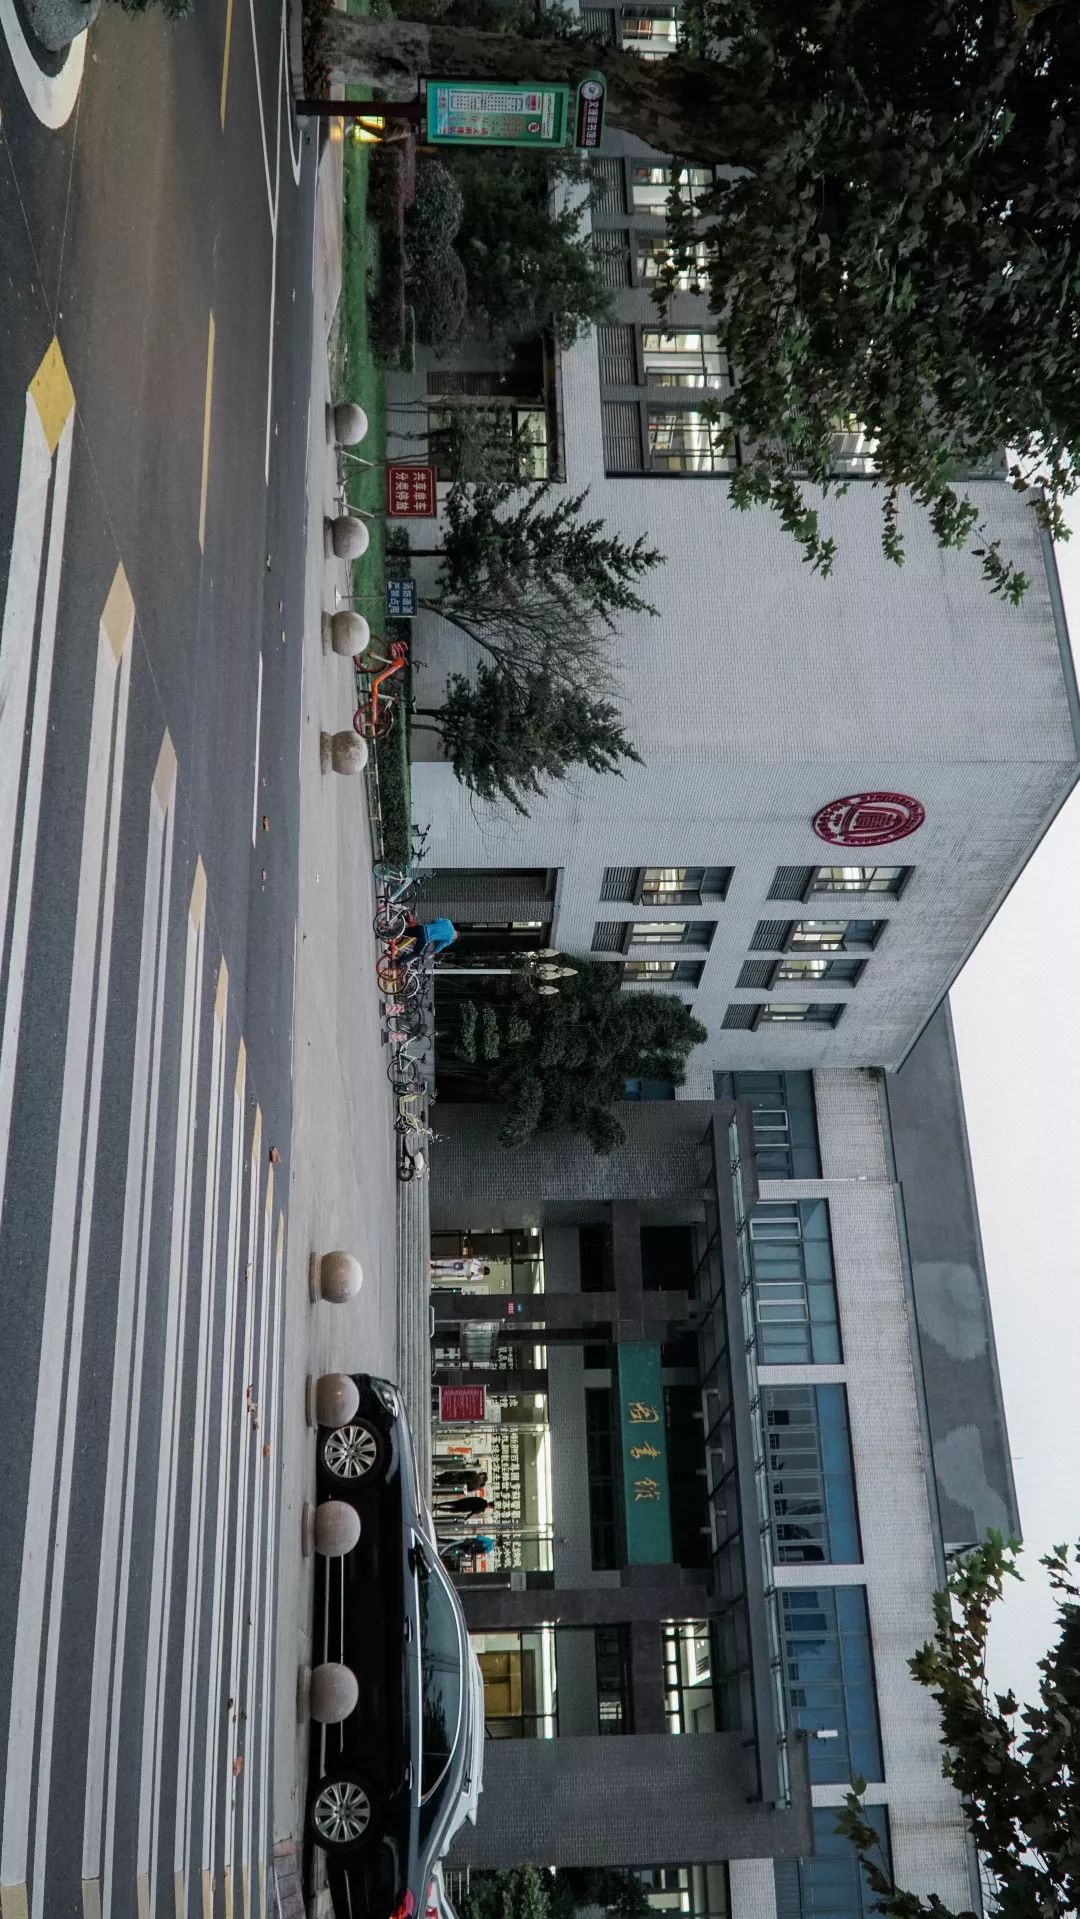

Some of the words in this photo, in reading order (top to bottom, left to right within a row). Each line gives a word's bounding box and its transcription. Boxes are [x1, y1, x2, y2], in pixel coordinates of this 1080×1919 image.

[395, 472, 408, 510] 分类停放
[413, 472, 427, 510] 共享单车
